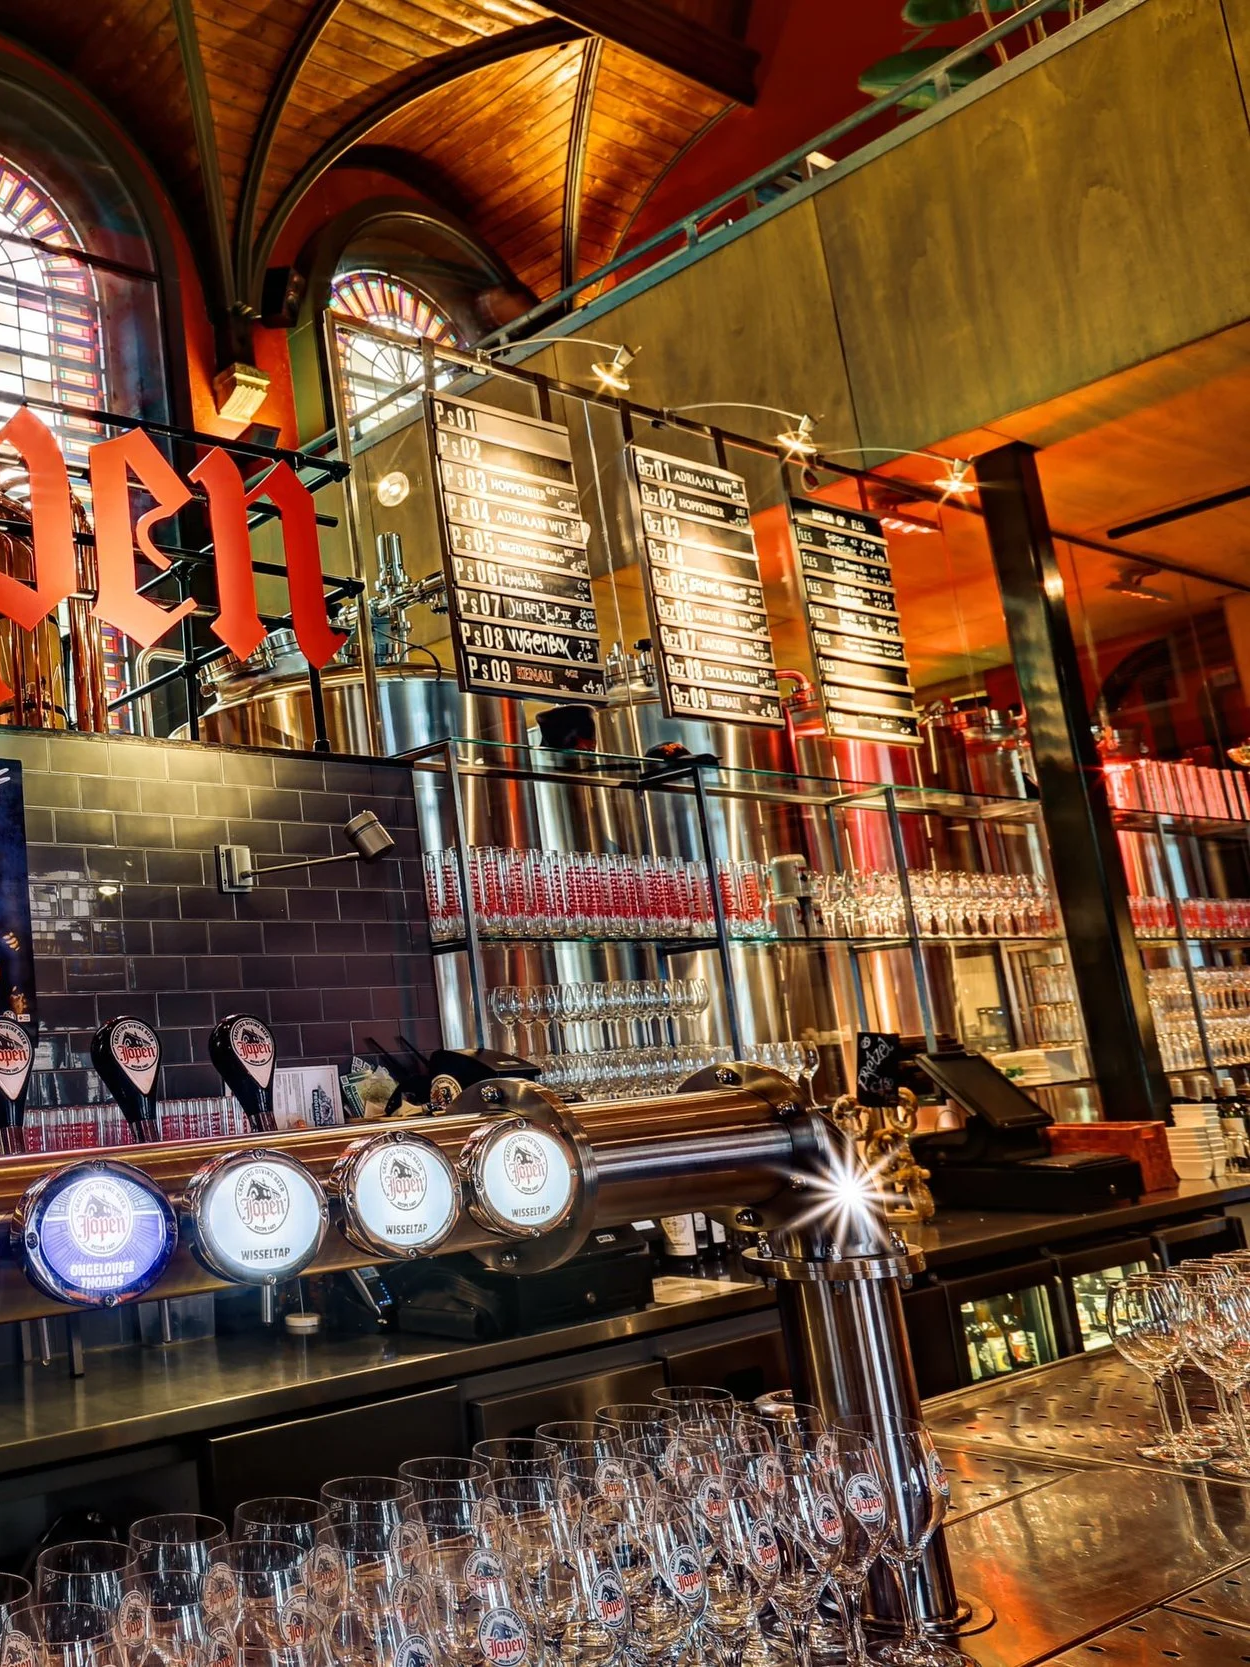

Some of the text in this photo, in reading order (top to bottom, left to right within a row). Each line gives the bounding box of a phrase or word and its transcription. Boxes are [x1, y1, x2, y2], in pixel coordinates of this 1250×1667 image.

[674, 470, 714, 490] ADRIAAN
[716, 481, 731, 494] WIT
[679, 498, 725, 517] HOPPENBIER
[497, 510, 547, 530] ADRIAAN
[548, 520, 567, 534] WIT
[704, 666, 731, 679] EXTRA
[732, 671, 758, 683] STOUT
[117, 1046, 156, 1065] Jopen
[237, 1042, 271, 1059] Jopen
[509, 1162, 545, 1187] Jopen
[385, 1175, 424, 1202] Jopen
[241, 1198, 285, 1225] Jopen
[511, 1205, 551, 1218] WISSELTAP
[77, 1215, 126, 1243] Jopen
[386, 1224, 428, 1234] WISSELTAP
[241, 1247, 290, 1260] WISSELTAP
[70, 1261, 135, 1277] ONGELOVIGE
[80, 1275, 124, 1289] THOMAS
[851, 1497, 883, 1515] Jopen
[485, 1639, 525, 1659] Jopen
